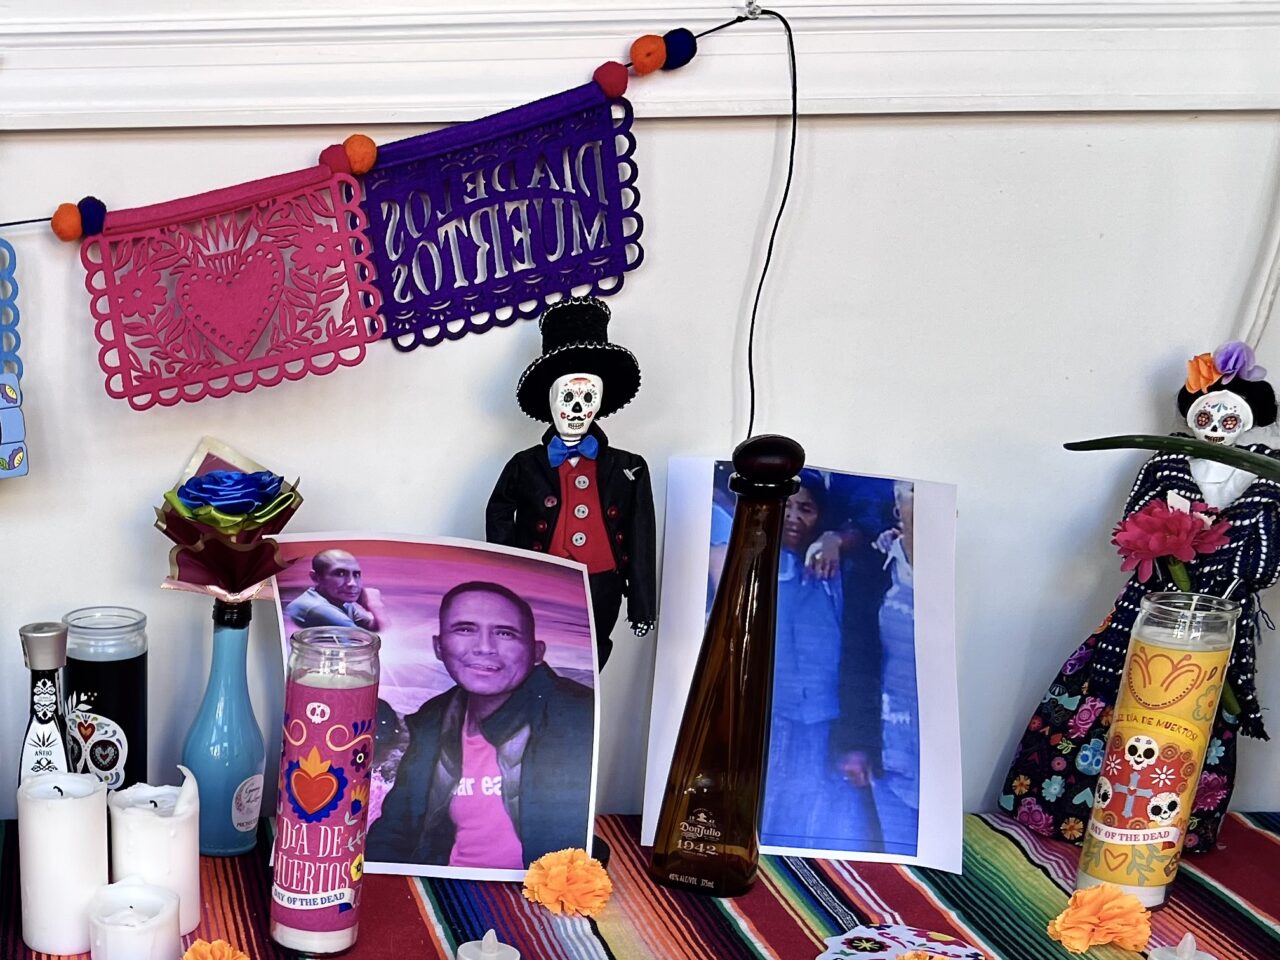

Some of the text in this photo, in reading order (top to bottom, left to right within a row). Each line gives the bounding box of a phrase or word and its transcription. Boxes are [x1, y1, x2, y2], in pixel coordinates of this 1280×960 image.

[1141, 716, 1154, 725] DE
[453, 777, 475, 796] ar
[317, 825, 344, 858] DE
[1091, 824, 1170, 842] DAY OF THE DEAD
[677, 839, 718, 856] 1942
[274, 851, 351, 894] MUERTOS
[287, 896, 298, 905] OF
[298, 898, 319, 906] THE
[320, 892, 345, 905] DEAD
